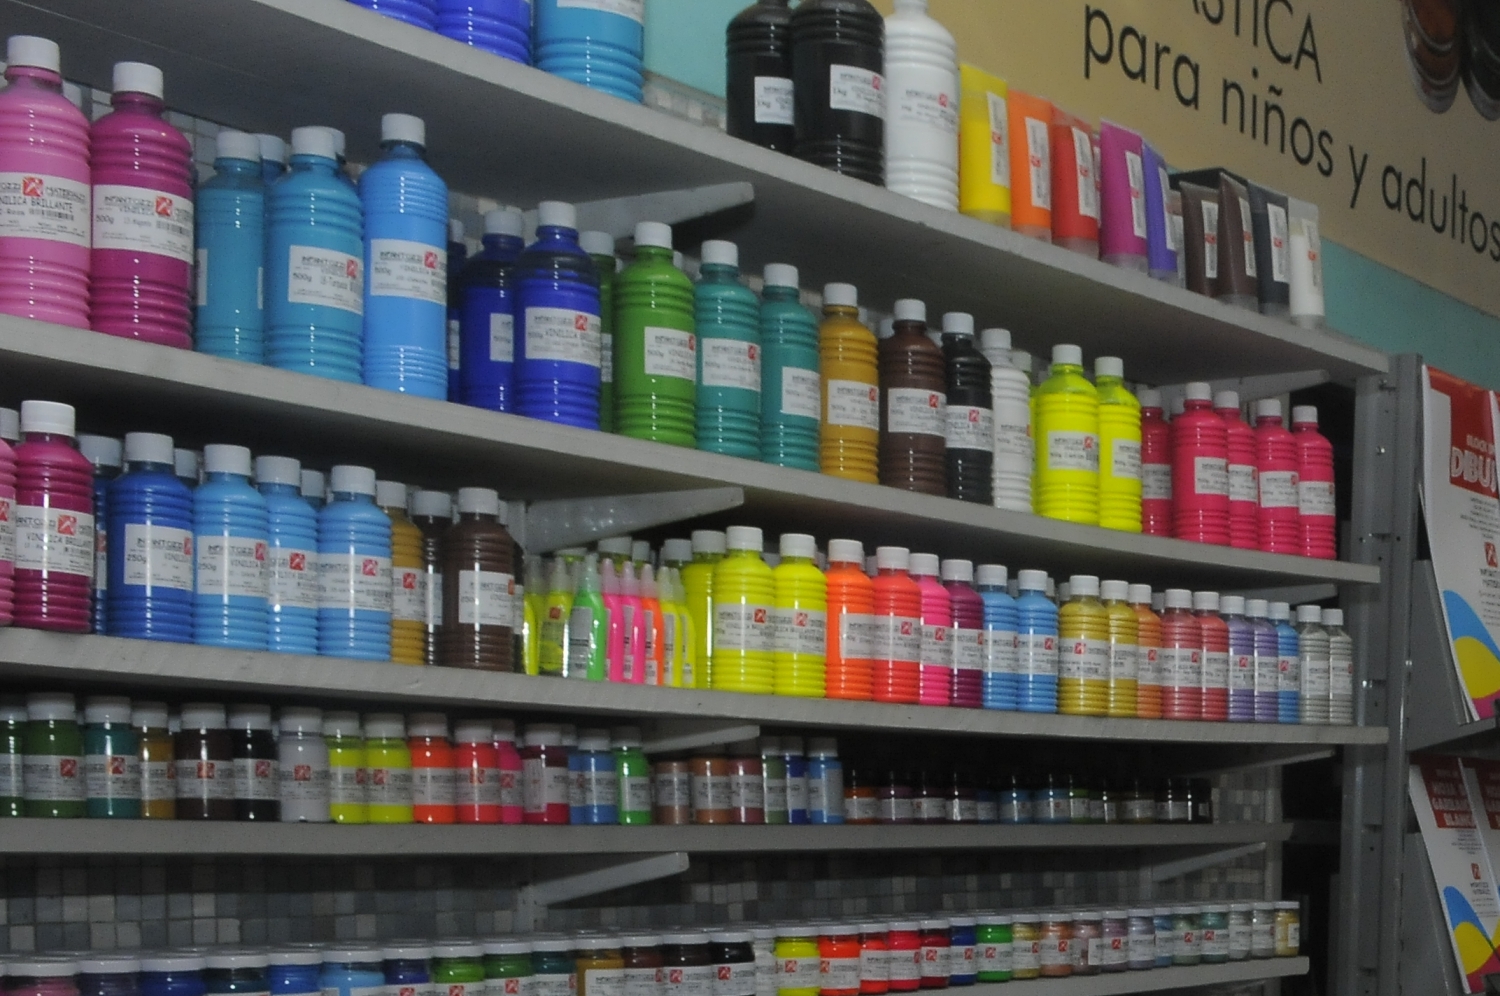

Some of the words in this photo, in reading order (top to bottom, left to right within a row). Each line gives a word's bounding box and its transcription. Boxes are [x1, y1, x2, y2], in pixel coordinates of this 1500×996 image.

[1084, 3, 1200, 110] para
[1221, 68, 1334, 178] niños
[1348, 144, 1369, 209] y
[1450, 446, 1496, 493] DIBUJ
